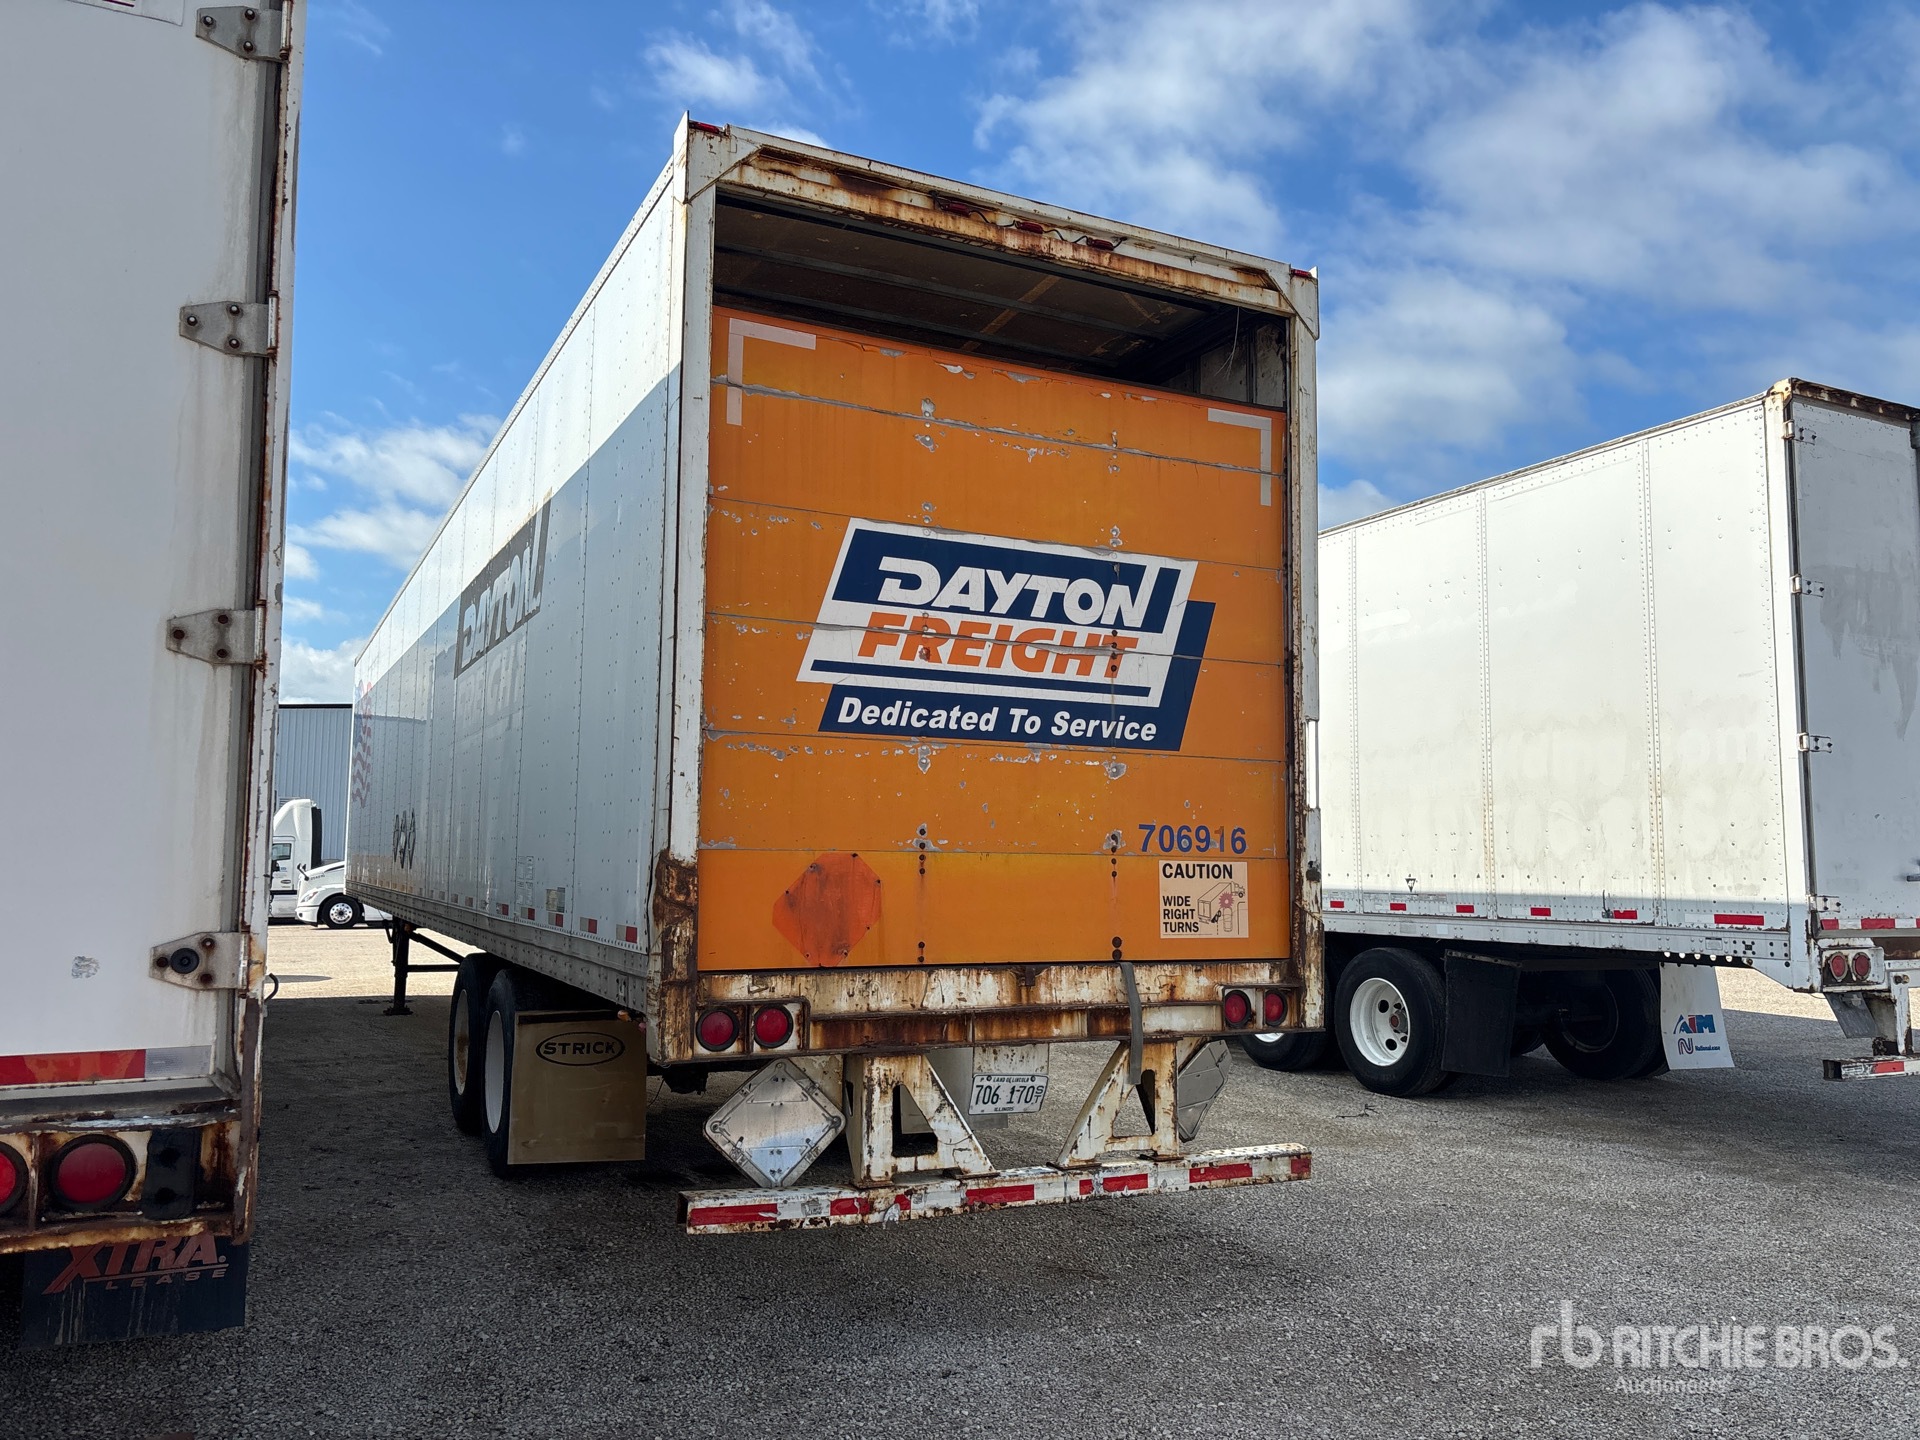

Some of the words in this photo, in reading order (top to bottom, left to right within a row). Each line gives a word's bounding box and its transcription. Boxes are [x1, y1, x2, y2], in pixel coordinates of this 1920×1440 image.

[877, 555, 1160, 629] DAYTON
[858, 611, 1139, 679] FREIGHT
[838, 696, 998, 732] Dedicated
[1009, 708, 1041, 734] To
[1050, 711, 1157, 741] Service
[1138, 824, 1247, 854] 706916
[1162, 863, 1233, 879] CAUTION
[1162, 896, 1191, 907] WIDE
[1163, 909, 1196, 919] RIGHT
[1163, 922, 1199, 933] TURNS
[543, 1041, 616, 1055] STRICK
[975, 1085, 1001, 1105] 706
[105, 1268, 227, 1290] LEASE
